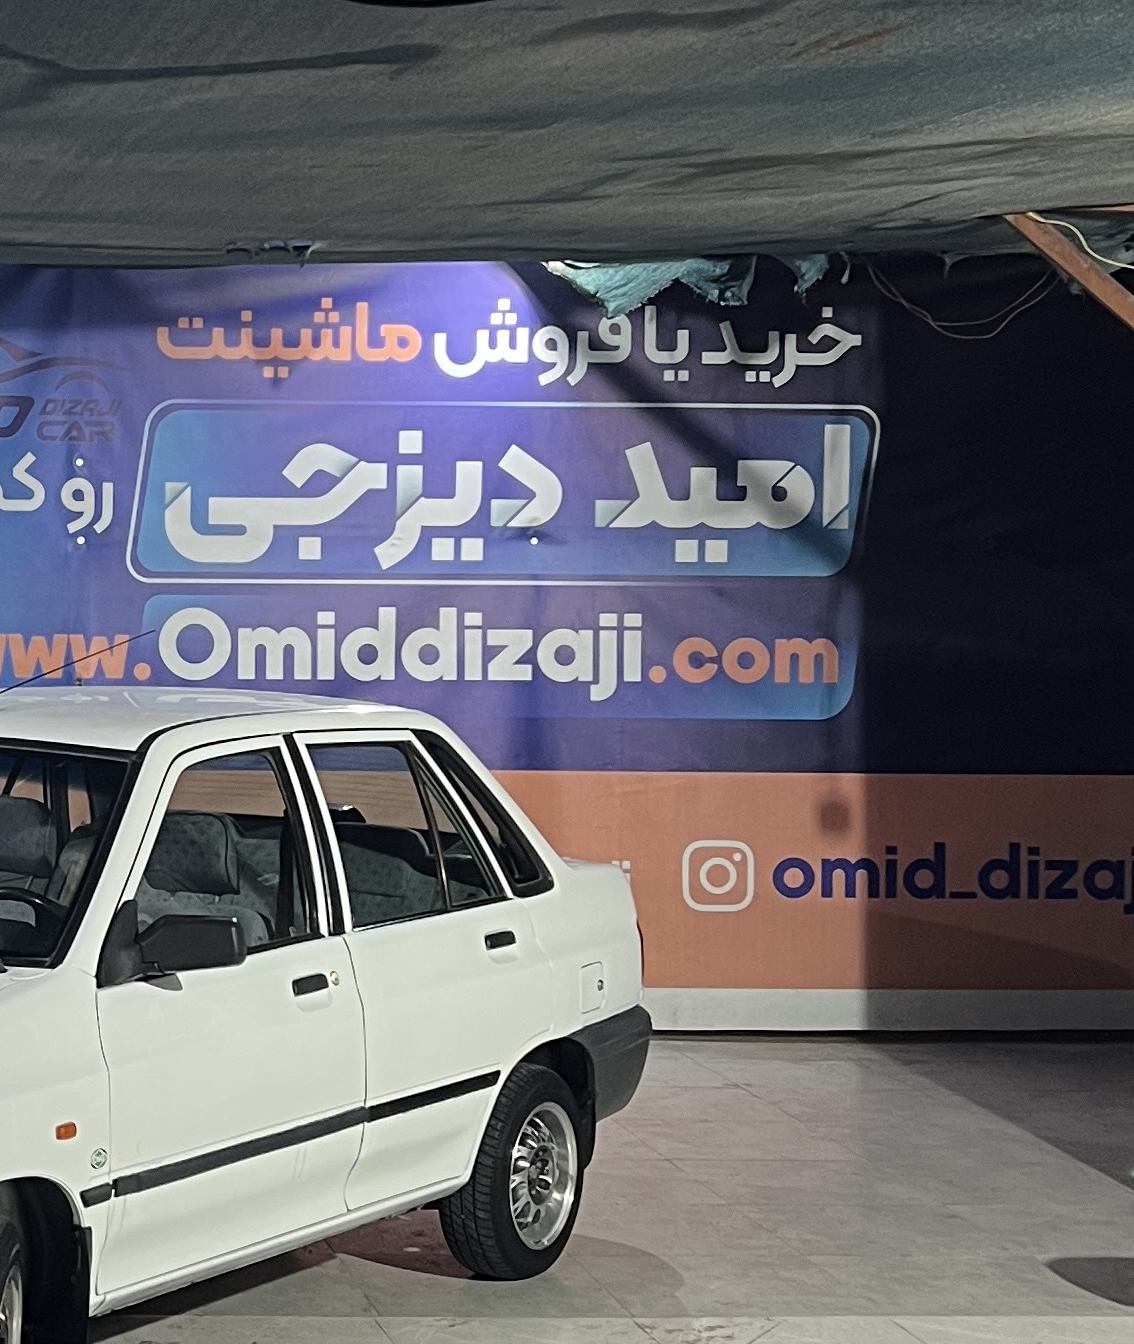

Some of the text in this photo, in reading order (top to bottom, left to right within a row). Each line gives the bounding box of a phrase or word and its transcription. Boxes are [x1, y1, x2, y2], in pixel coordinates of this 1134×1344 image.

[157, 297, 862, 389] خرید یا فروش ماشینت
[36, 420, 116, 442] CAR
[60, 477, 114, 534] رو
[164, 424, 850, 570] امید دیزجی
